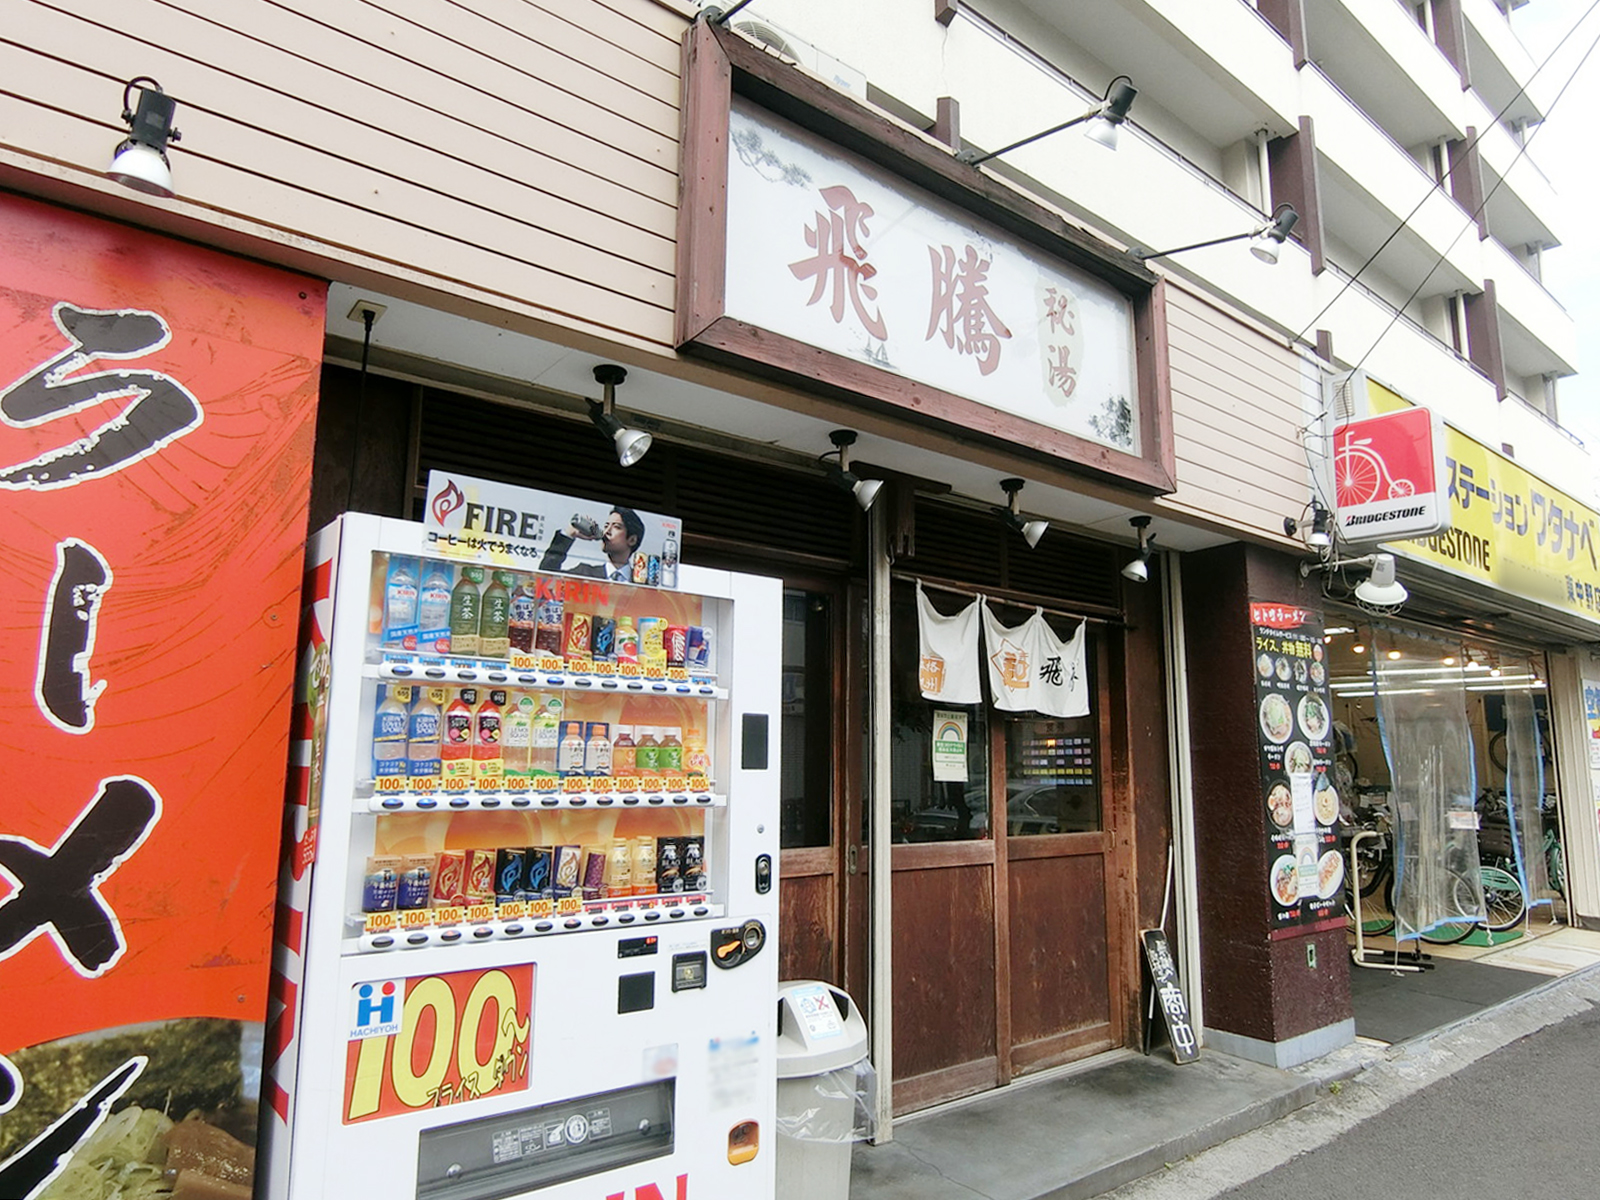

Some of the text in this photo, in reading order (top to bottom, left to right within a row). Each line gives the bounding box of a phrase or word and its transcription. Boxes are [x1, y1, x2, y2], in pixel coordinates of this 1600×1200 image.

[787, 184, 1012, 377] 飛騰
[1043, 286, 1078, 399] 秘湯
[464, 502, 540, 540] FIRE
[1344, 505, 1427, 527] BRIDGESTONE
[1408, 527, 1491, 572] ESTONE
[534, 576, 611, 607] KIRIN
[461, 595, 474, 620] 生茶
[492, 598, 505, 623] 生茶
[350, 1024, 398, 1038] HACHIYOH
